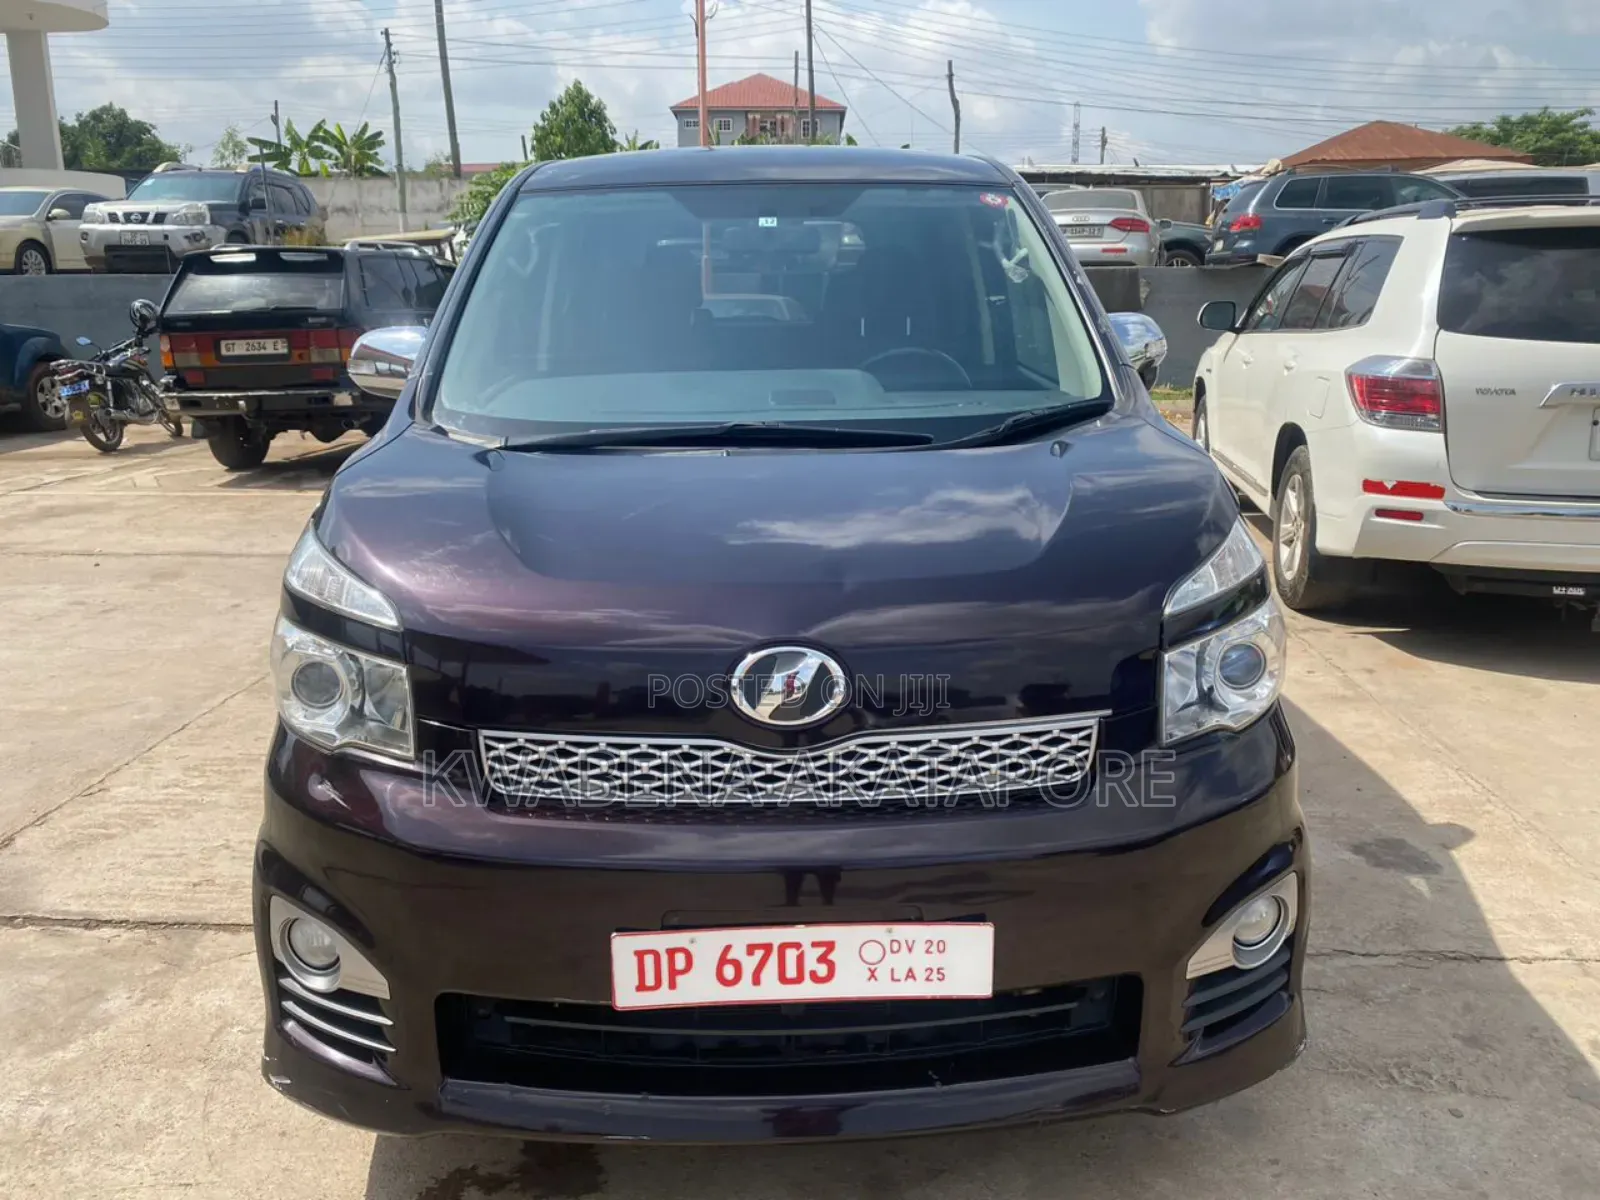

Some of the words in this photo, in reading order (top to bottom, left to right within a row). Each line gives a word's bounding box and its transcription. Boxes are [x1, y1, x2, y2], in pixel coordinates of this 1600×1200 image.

[224, 342, 236, 353] GT
[245, 341, 267, 352] 2634
[273, 340, 280, 351] E
[889, 939, 915, 954] DV
[924, 939, 946, 954] 20
[633, 946, 694, 992] DP
[715, 939, 837, 988] 6703
[867, 967, 878, 982] X
[890, 967, 917, 982] LA
[924, 967, 946, 982] 25
